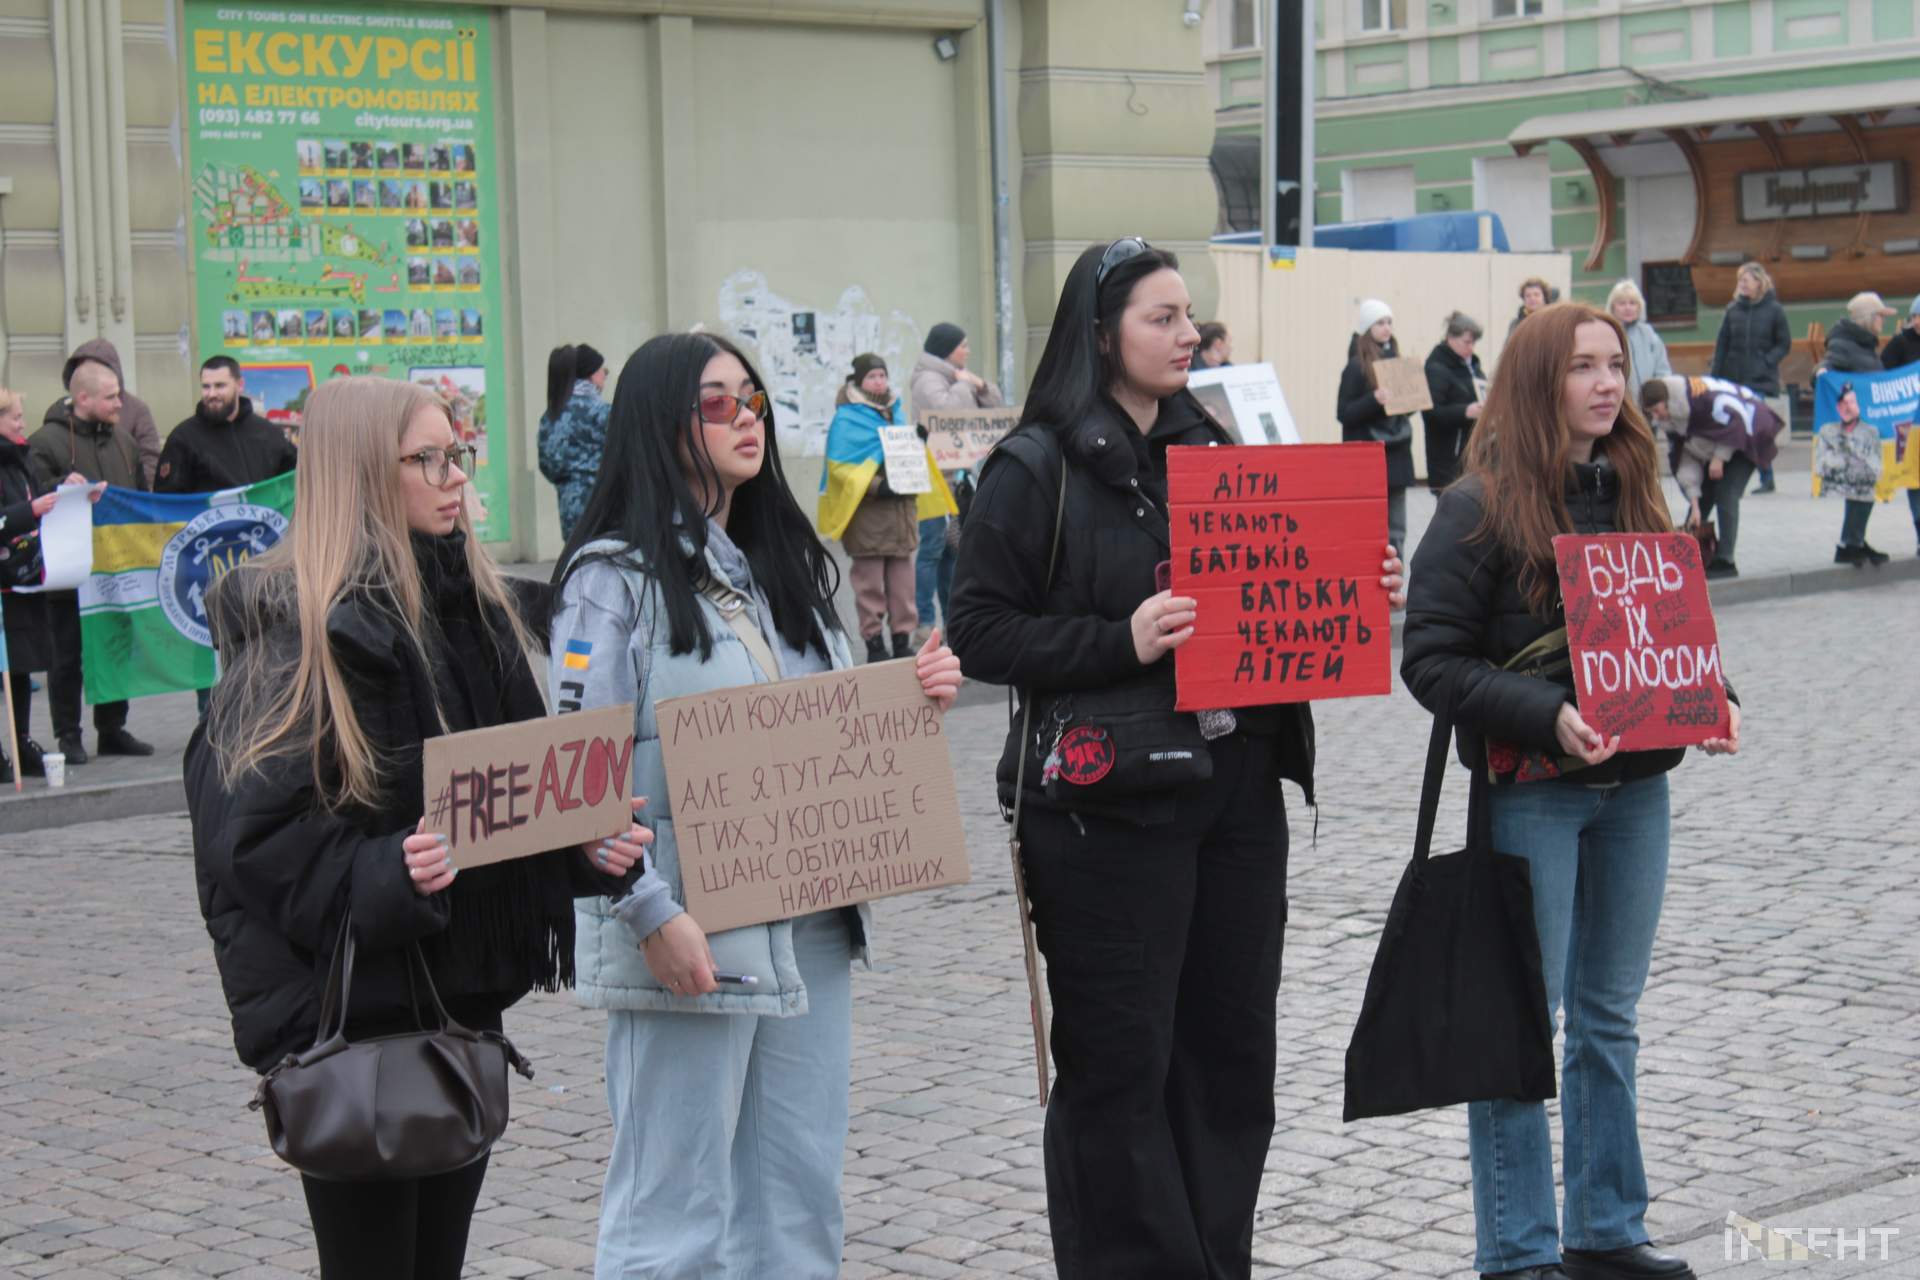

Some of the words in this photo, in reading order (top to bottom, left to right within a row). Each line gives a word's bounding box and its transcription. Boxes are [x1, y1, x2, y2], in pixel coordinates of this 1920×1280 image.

[217, 9, 243, 21] CITY
[246, 10, 286, 23] TOURS
[289, 13, 306, 24] ON
[309, 13, 363, 26] ELECTRIC
[366, 16, 414, 29] SHUTTLE
[417, 18, 454, 30] BUSES
[194, 27, 477, 82] ЕКСКУРСІЇ
[197, 83, 238, 106] НА
[245, 84, 480, 112] ЕЛЕКТРОМОБІЛЯХ
[200, 108, 240, 126] (093)
[277, 110, 297, 125] 77
[355, 112, 473, 131] citytours.org.ua
[1188, 511, 1298, 535] ЧЕКАЮТЬ
[1188, 537, 1310, 575] БАТЬКІВ
[1584, 540, 1684, 599] БУДЬ
[1240, 577, 1360, 613] БАТЬКИ
[1237, 615, 1372, 646] ЧЕКАЮТЬ
[1617, 595, 1654, 651] ЇХ
[1234, 645, 1345, 684] ДІТЕЙ
[1581, 643, 1724, 696] ГОЛОСОМ
[673, 696, 736, 747] МІЙ
[745, 677, 861, 731] КОХАНИЙ
[836, 705, 941, 751] ЗАГИНУВ
[680, 772, 731, 814] АЛЕ
[750, 766, 771, 802] Я
[772, 756, 824, 796] ТУТ
[828, 748, 904, 786] ДЛЯ
[686, 818, 762, 856] ТИХ,
[911, 784, 927, 815] Є
[699, 853, 782, 893] ШАНС
[786, 827, 912, 877] ОБІЙНЯТИ
[779, 856, 945, 914] НАЙРІДНІШИХ
